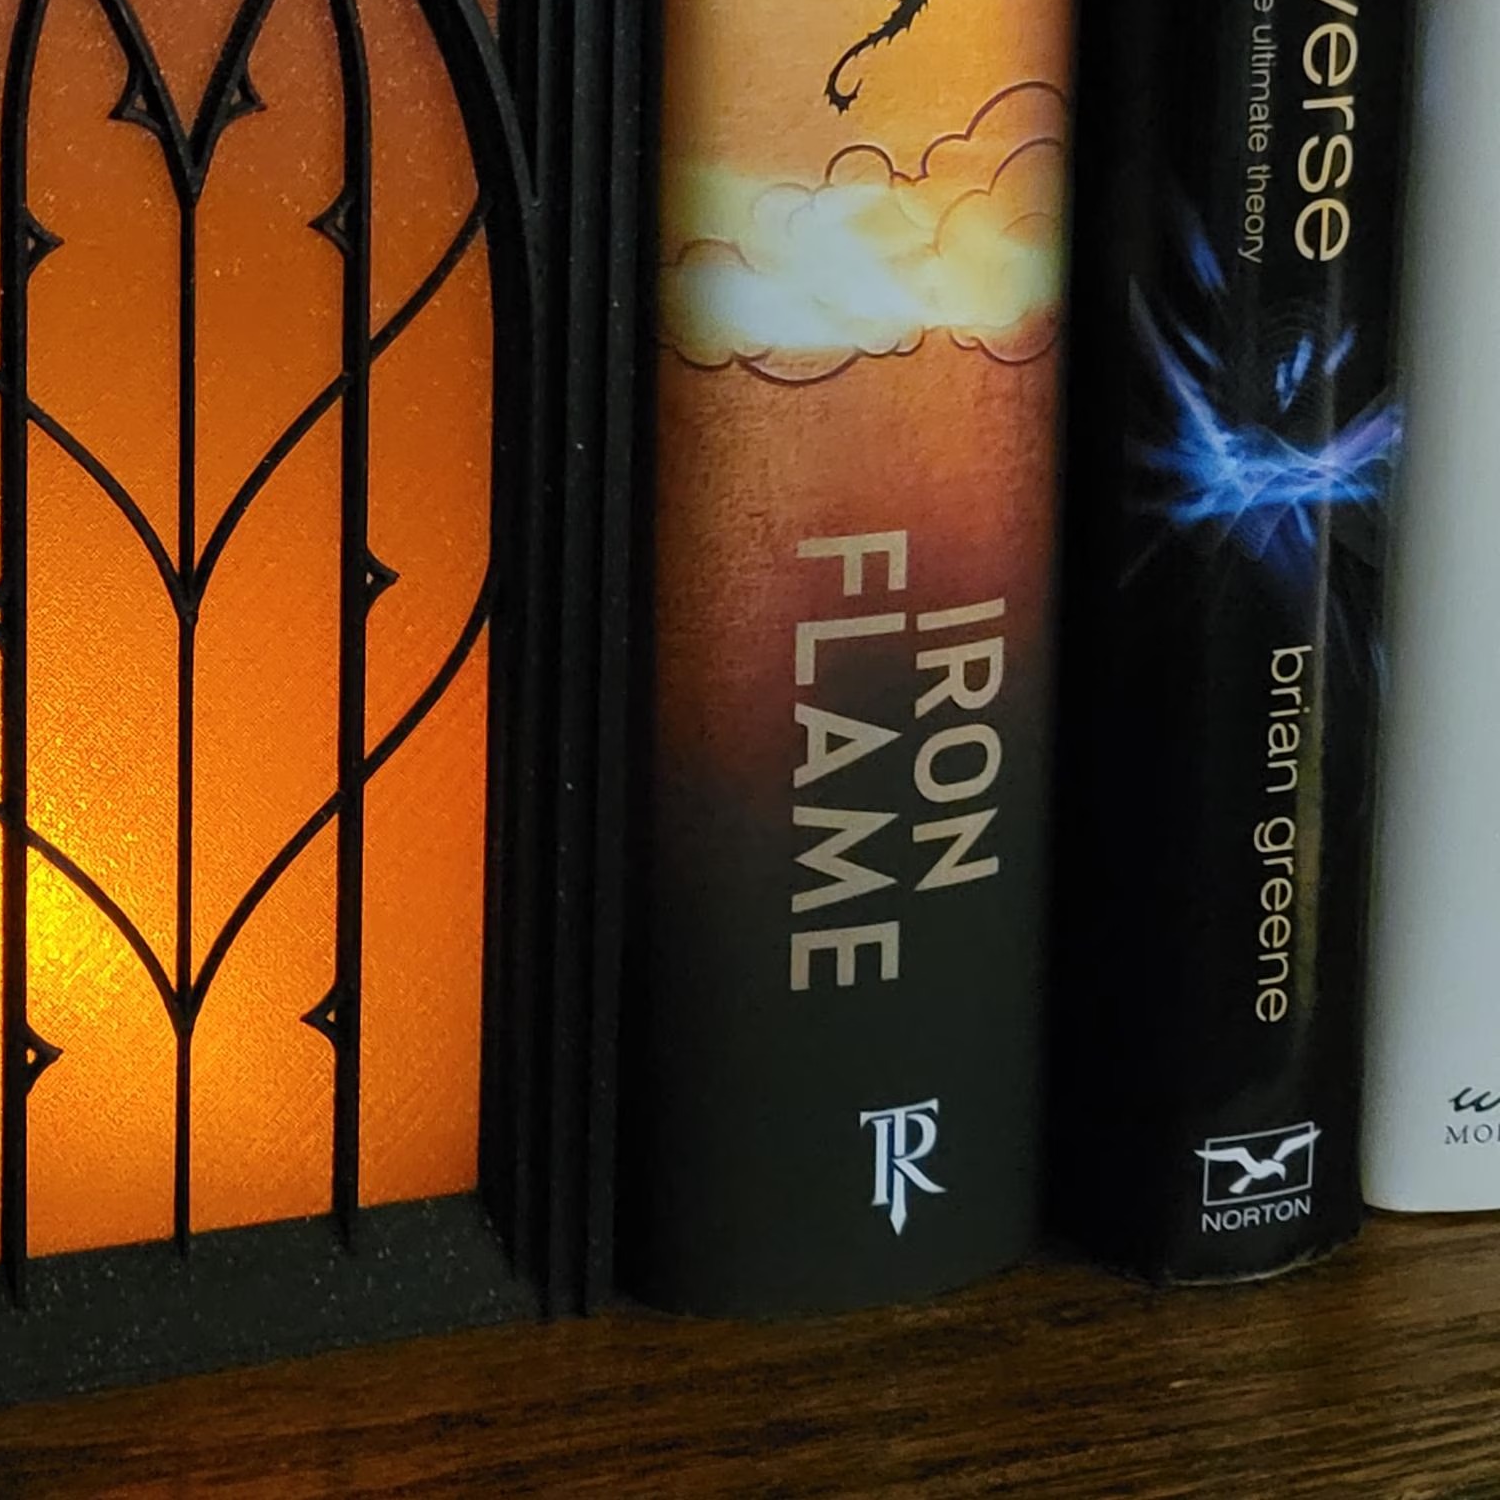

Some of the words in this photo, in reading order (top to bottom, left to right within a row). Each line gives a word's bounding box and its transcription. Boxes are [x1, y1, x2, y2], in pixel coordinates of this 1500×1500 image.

[1248, 24, 1277, 152] ultimate
[1237, 164, 1272, 263] theory
[791, 530, 907, 991] FLAME
[912, 597, 1005, 892] IRON
[1267, 645, 1312, 794] brian
[1253, 816, 1296, 1022] greene
[1444, 1123, 1500, 1145] MO
[1202, 1195, 1311, 1232] NORTON
